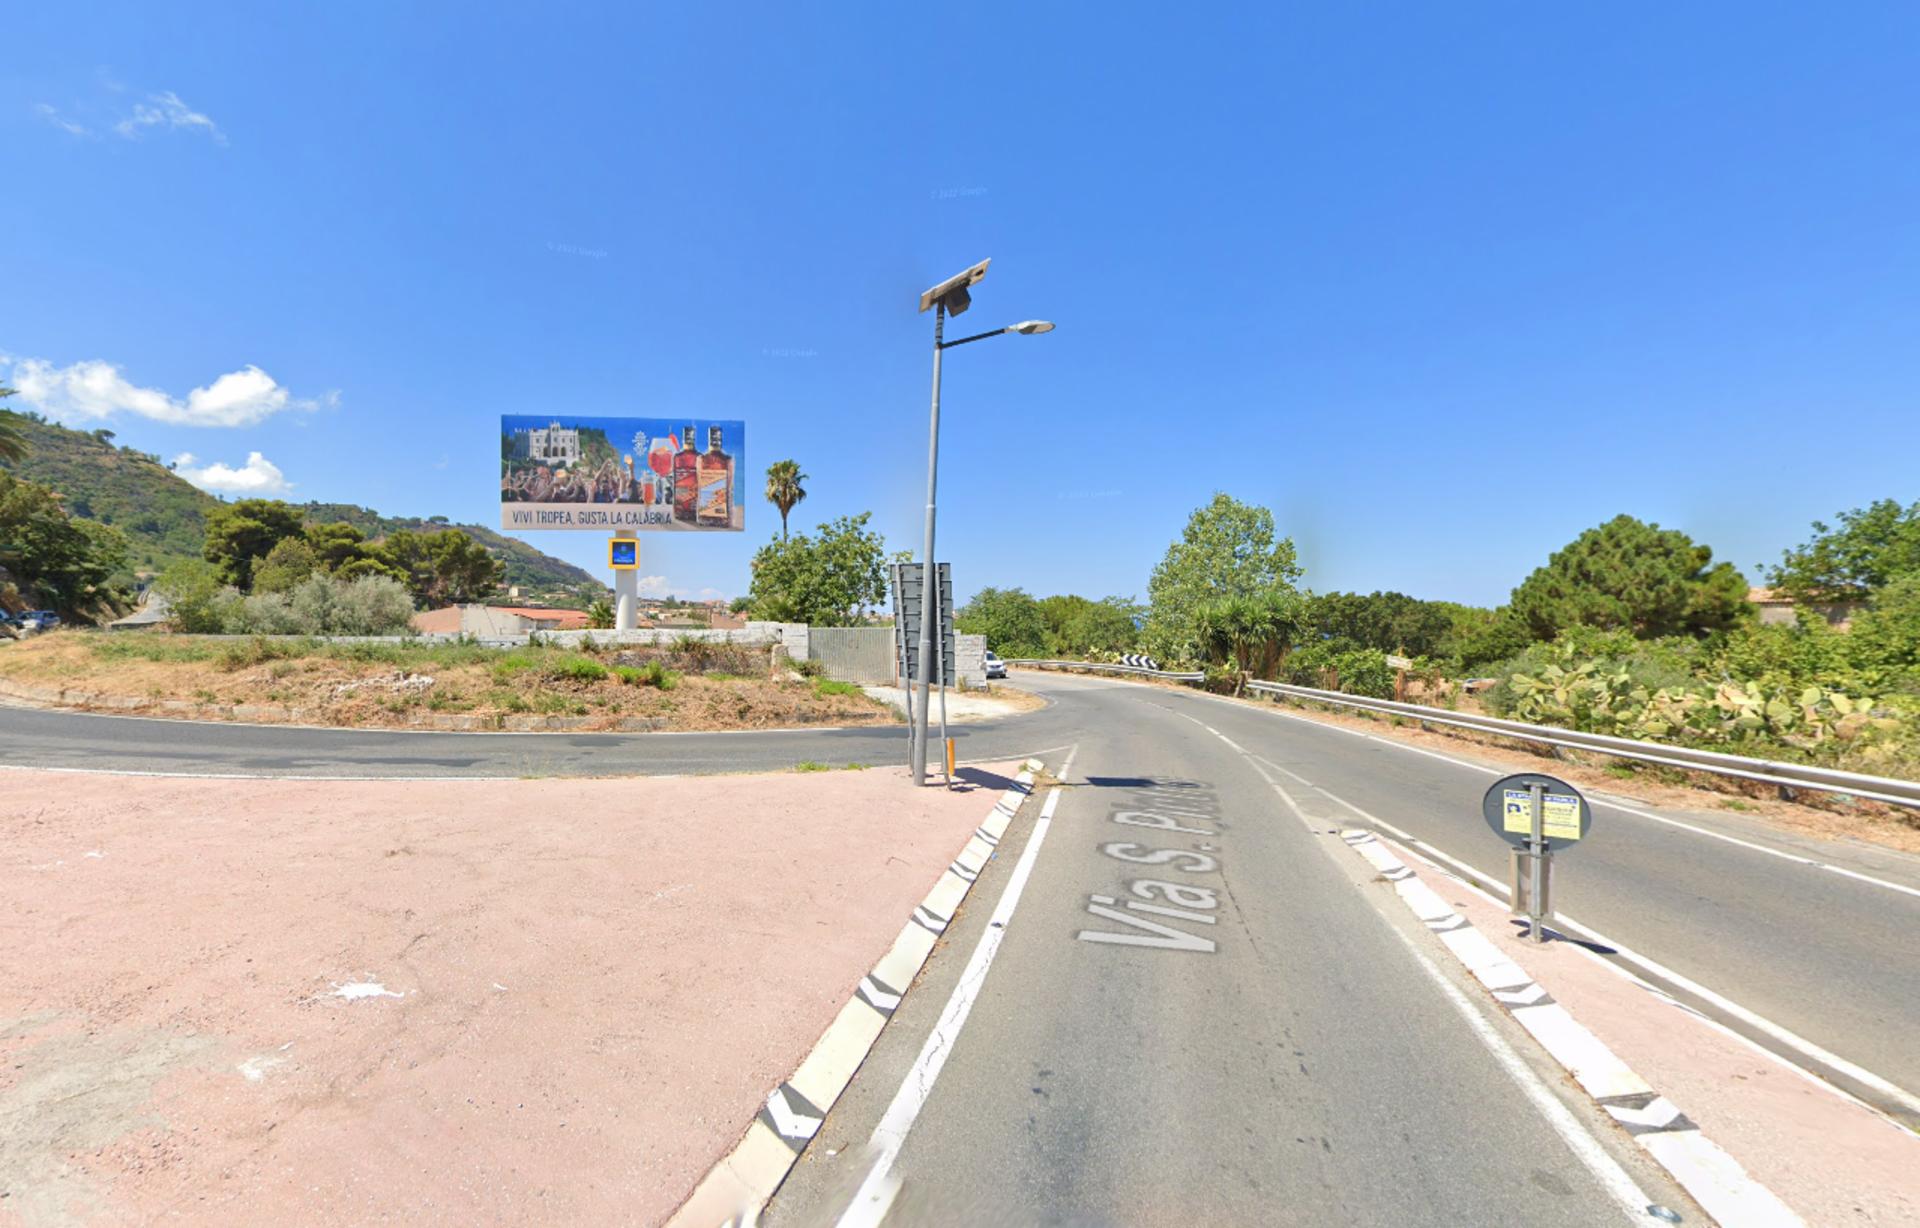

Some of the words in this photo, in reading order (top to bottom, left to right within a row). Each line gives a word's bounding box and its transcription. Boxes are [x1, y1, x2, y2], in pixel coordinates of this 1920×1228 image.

[513, 510, 533, 524] VIVI
[536, 511, 575, 525] TROPEA,
[578, 511, 608, 525] GUSTA
[611, 511, 623, 525] LA
[625, 511, 672, 526] CALABRIA
